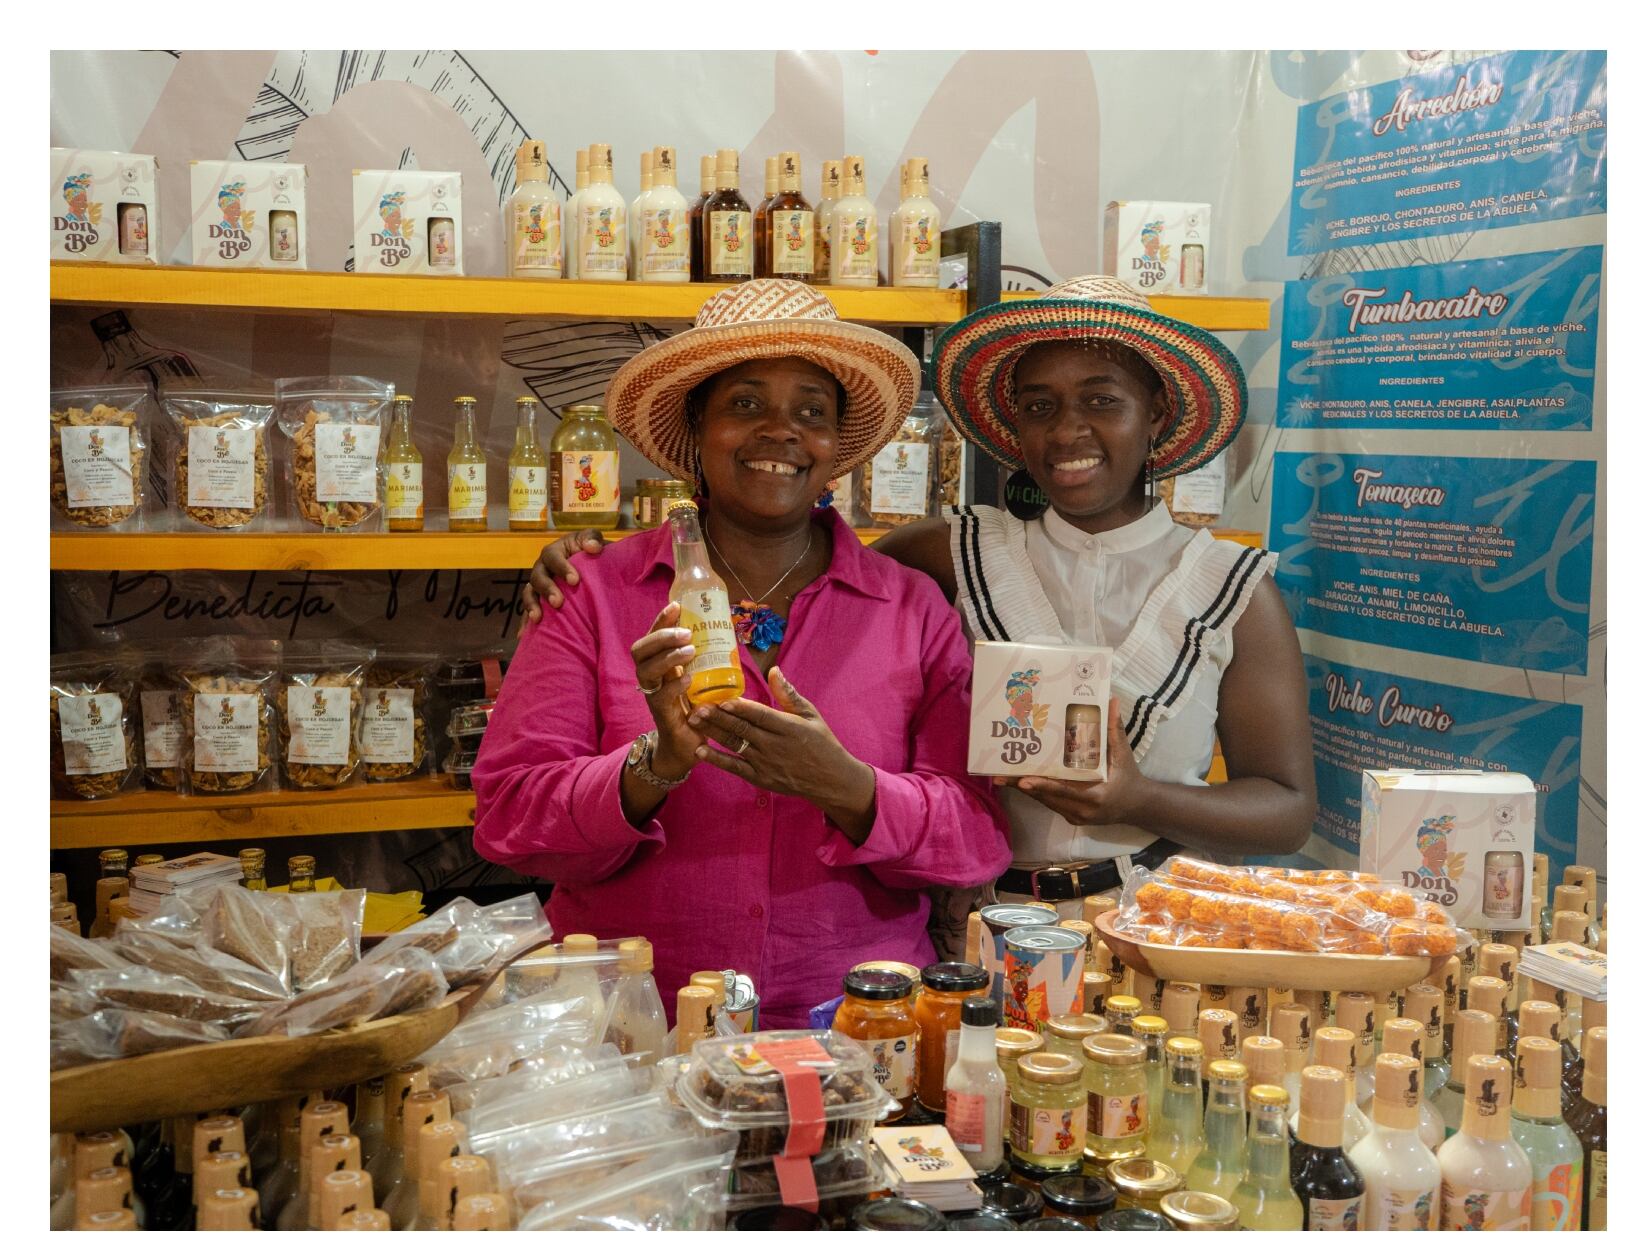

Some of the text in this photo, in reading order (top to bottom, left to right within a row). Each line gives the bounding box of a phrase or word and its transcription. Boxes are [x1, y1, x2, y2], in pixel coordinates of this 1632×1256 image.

[1396, 120, 1549, 156] 100% natural y artesanal base
[1346, 163, 1377, 176] bebida
[1494, 137, 1520, 149] sirve
[1521, 133, 1545, 148] para
[1547, 128, 1557, 139] la
[1394, 179, 1462, 198] INGREDIENTES
[1500, 189, 1549, 204] CANELA,
[53, 216, 93, 232] Don
[1373, 202, 1539, 234] Y LOS SECRETOS DE LA ABUELA
[64, 228, 99, 253] Be
[209, 224, 246, 240] Don
[370, 233, 406, 248] Don
[218, 236, 252, 260] Be
[379, 244, 411, 267] Be
[1131, 257, 1162, 271] Don
[1138, 268, 1166, 288] Be
[1342, 286, 1508, 333] Tumbacatre
[1380, 333, 1406, 343] 100%
[1409, 330, 1444, 341] natural
[1445, 332, 1451, 341] y
[1451, 327, 1500, 339] artesanal
[1509, 325, 1535, 336] base
[1536, 324, 1551, 334] de
[1363, 344, 1395, 354] bebida
[1449, 343, 1457, 352] y
[1544, 335, 1556, 345] el
[1418, 350, 1468, 362] brindando
[1469, 348, 1512, 360] vitalidad
[1513, 348, 1525, 358] al
[1378, 375, 1446, 386] INGREDIENTES
[1368, 409, 1376, 418] Y
[1376, 409, 1394, 419] LOS
[1395, 409, 1446, 419] SECRETOS
[1447, 409, 1462, 419] DE
[1463, 409, 1477, 419] LA
[1353, 468, 1447, 509] Tomaseca
[1384, 517, 1393, 526] de
[1403, 519, 1427, 530] plantas
[1475, 525, 1498, 535] ayuda
[1394, 539, 1424, 550] fortalece
[1457, 544, 1467, 553] En
[1468, 546, 1479, 555] los
[1479, 547, 1513, 558] hombres
[1487, 536, 1516, 547] dolores
[1359, 567, 1421, 583] INGREDIENTES
[1382, 587, 1404, 599] MIEL
[1406, 589, 1421, 600] DE
[93, 569, 344, 641] Benedicta
[1404, 601, 1467, 620] LIMONCILLO,
[1356, 607, 1375, 618] LOS
[1375, 609, 1427, 626] SECRETOS
[1427, 616, 1441, 628] DE
[1443, 620, 1458, 631] LA
[1326, 673, 1374, 714] Viche
[990, 720, 1038, 739] Don
[1000, 736, 1042, 765] Be
[1361, 743, 1376, 756] por
[1388, 750, 1423, 767] parteras
[1377, 734, 1405, 750] natural
[1459, 755, 1486, 769] reina
[1487, 761, 1509, 773] con
[1401, 870, 1453, 891] Don
